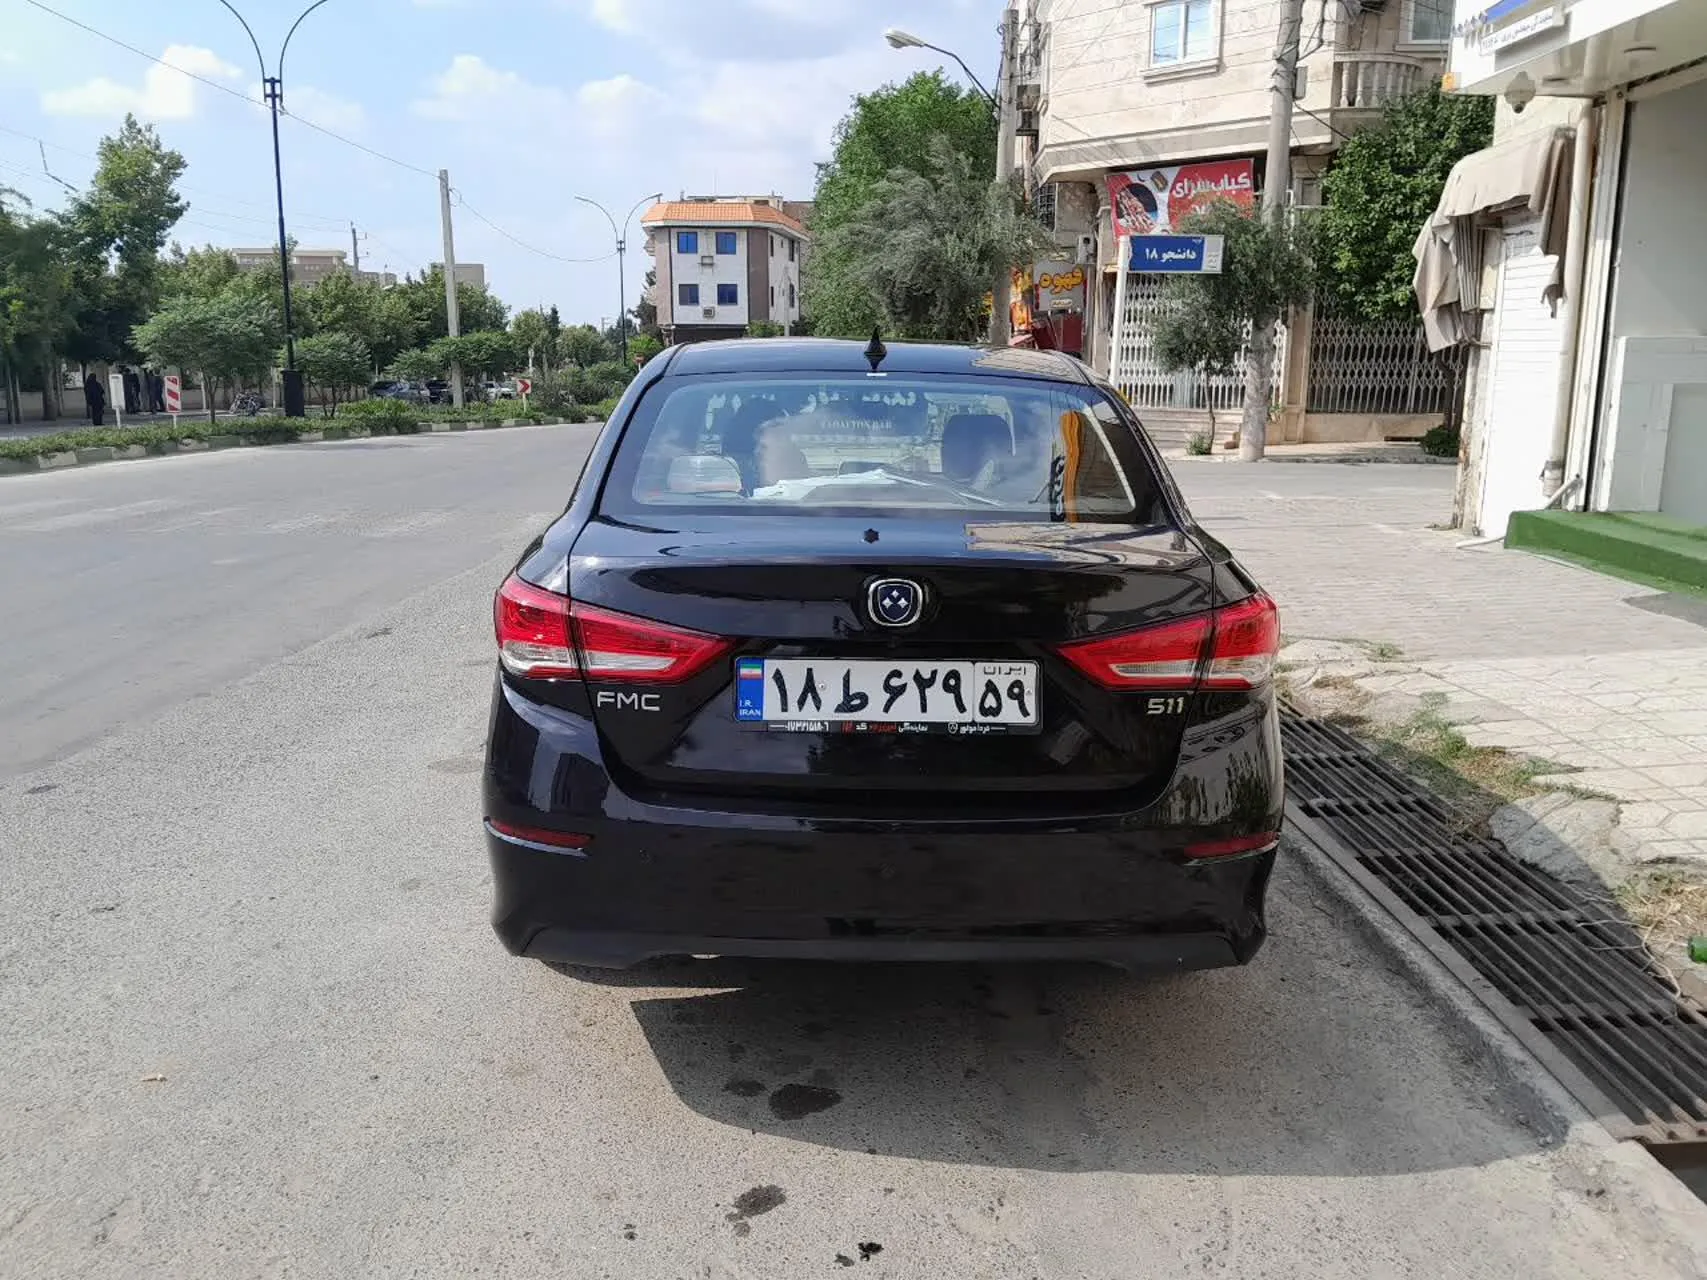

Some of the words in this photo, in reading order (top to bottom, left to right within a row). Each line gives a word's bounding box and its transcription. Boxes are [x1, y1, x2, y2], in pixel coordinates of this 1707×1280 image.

[1145, 247, 1158, 260] ۱۸
[1160, 247, 1197, 263] دانشجو
[983, 665, 1026, 676] ایران
[597, 691, 660, 711] FMC
[979, 678, 1031, 718] ۵۹
[739, 709, 761, 717] IRAN
